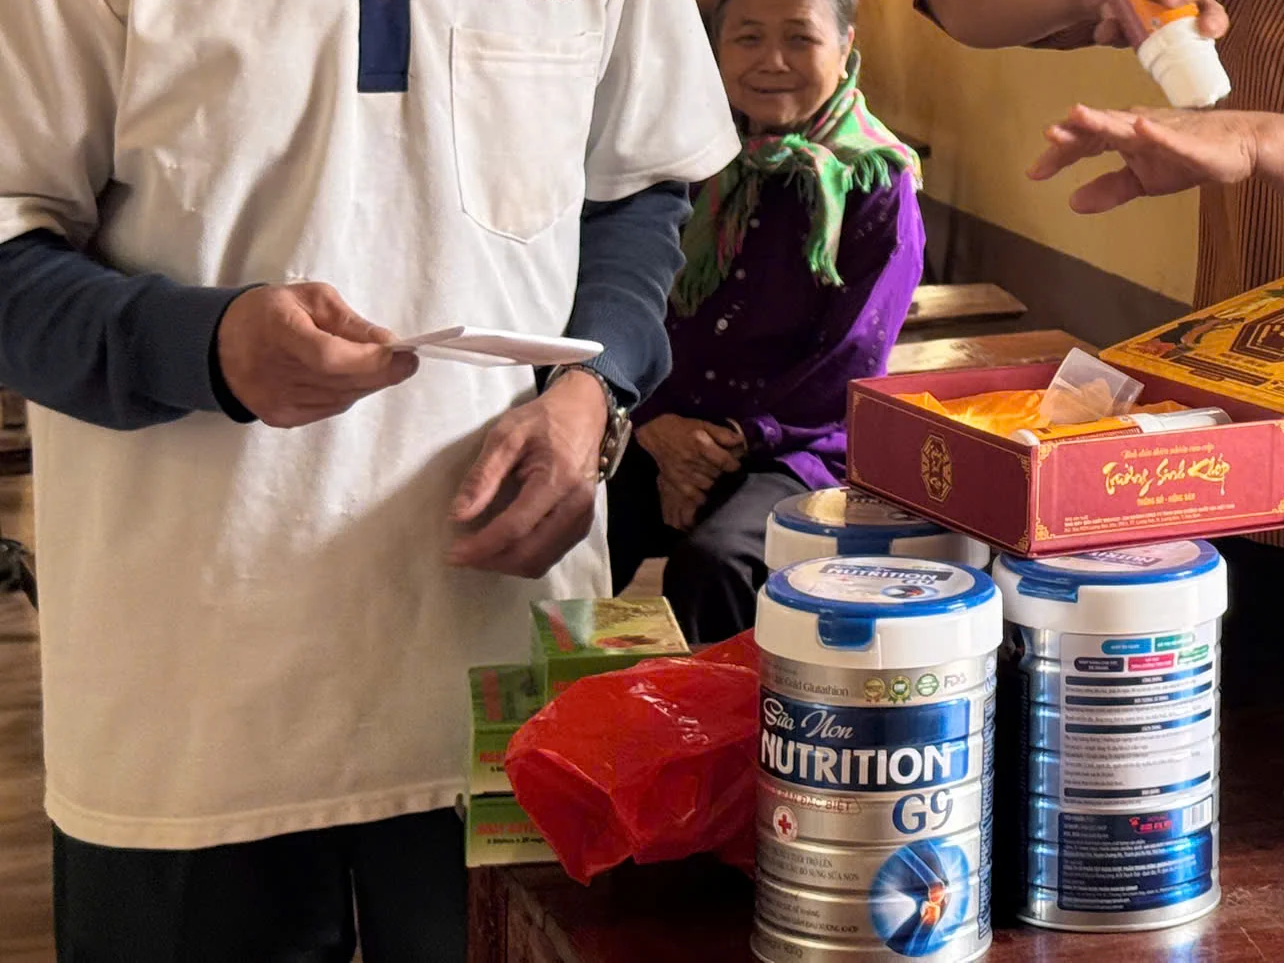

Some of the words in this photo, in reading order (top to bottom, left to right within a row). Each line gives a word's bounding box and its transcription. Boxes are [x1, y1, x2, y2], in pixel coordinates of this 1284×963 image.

[826, 567, 938, 581] NUTRITION
[801, 709, 855, 740] Non
[760, 729, 952, 786] NUTRITION
[892, 788, 954, 835] G9
